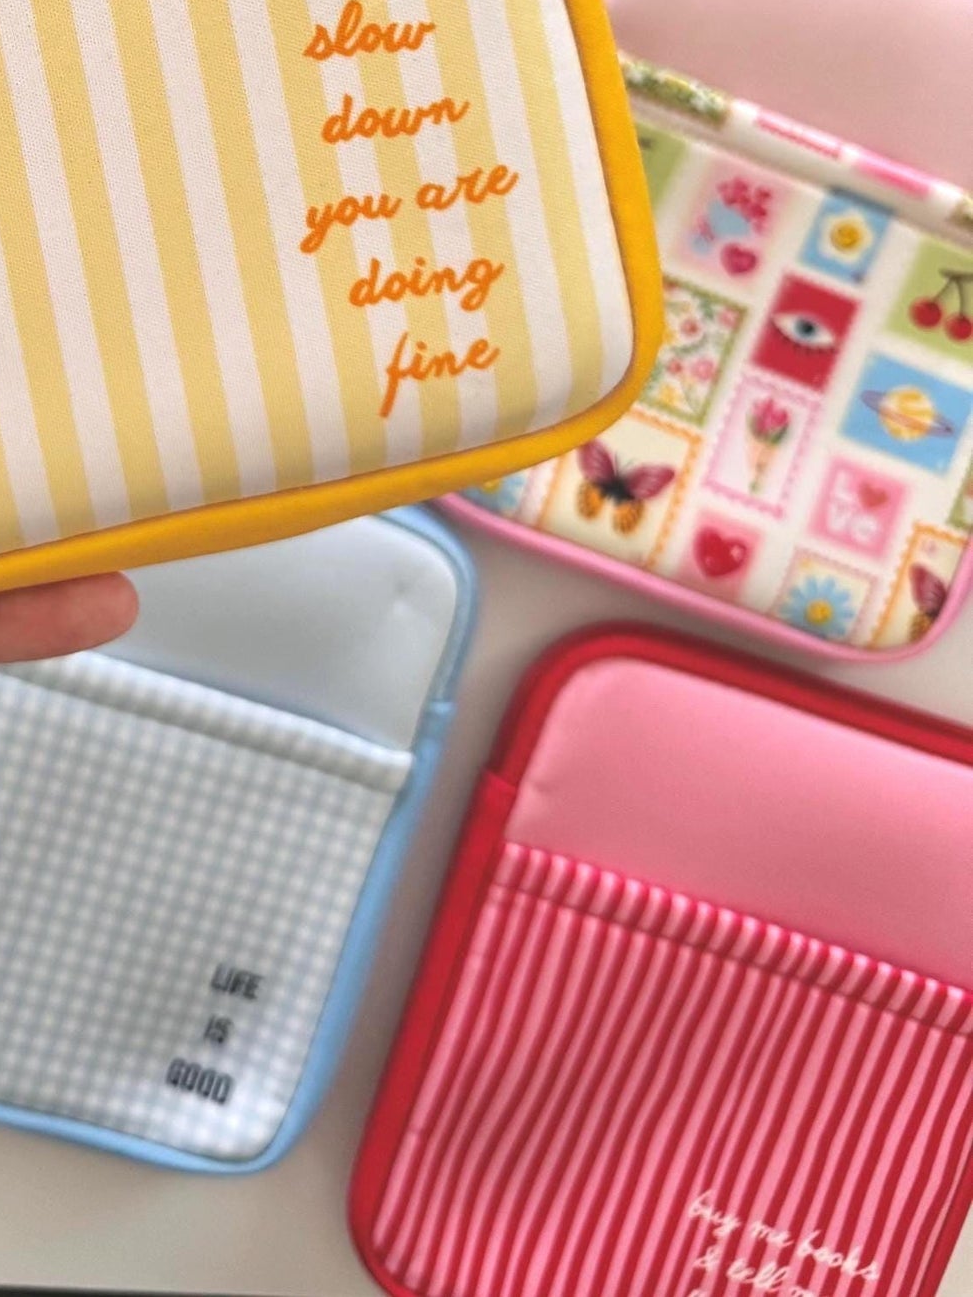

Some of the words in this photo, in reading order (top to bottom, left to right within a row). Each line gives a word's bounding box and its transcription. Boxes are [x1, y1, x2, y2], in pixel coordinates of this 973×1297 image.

[304, 0, 436, 61] slow
[321, 93, 470, 145] down
[299, 193, 403, 254] you
[416, 163, 520, 212] are
[349, 256, 505, 312] doing
[378, 331, 500, 419] fine
[211, 963, 265, 1001] LIFE
[204, 1015, 233, 1045] IS
[165, 1057, 234, 1106] GOOD
[688, 1190, 742, 1238] buy
[749, 1220, 795, 1248] me
[797, 1229, 880, 1283] books
